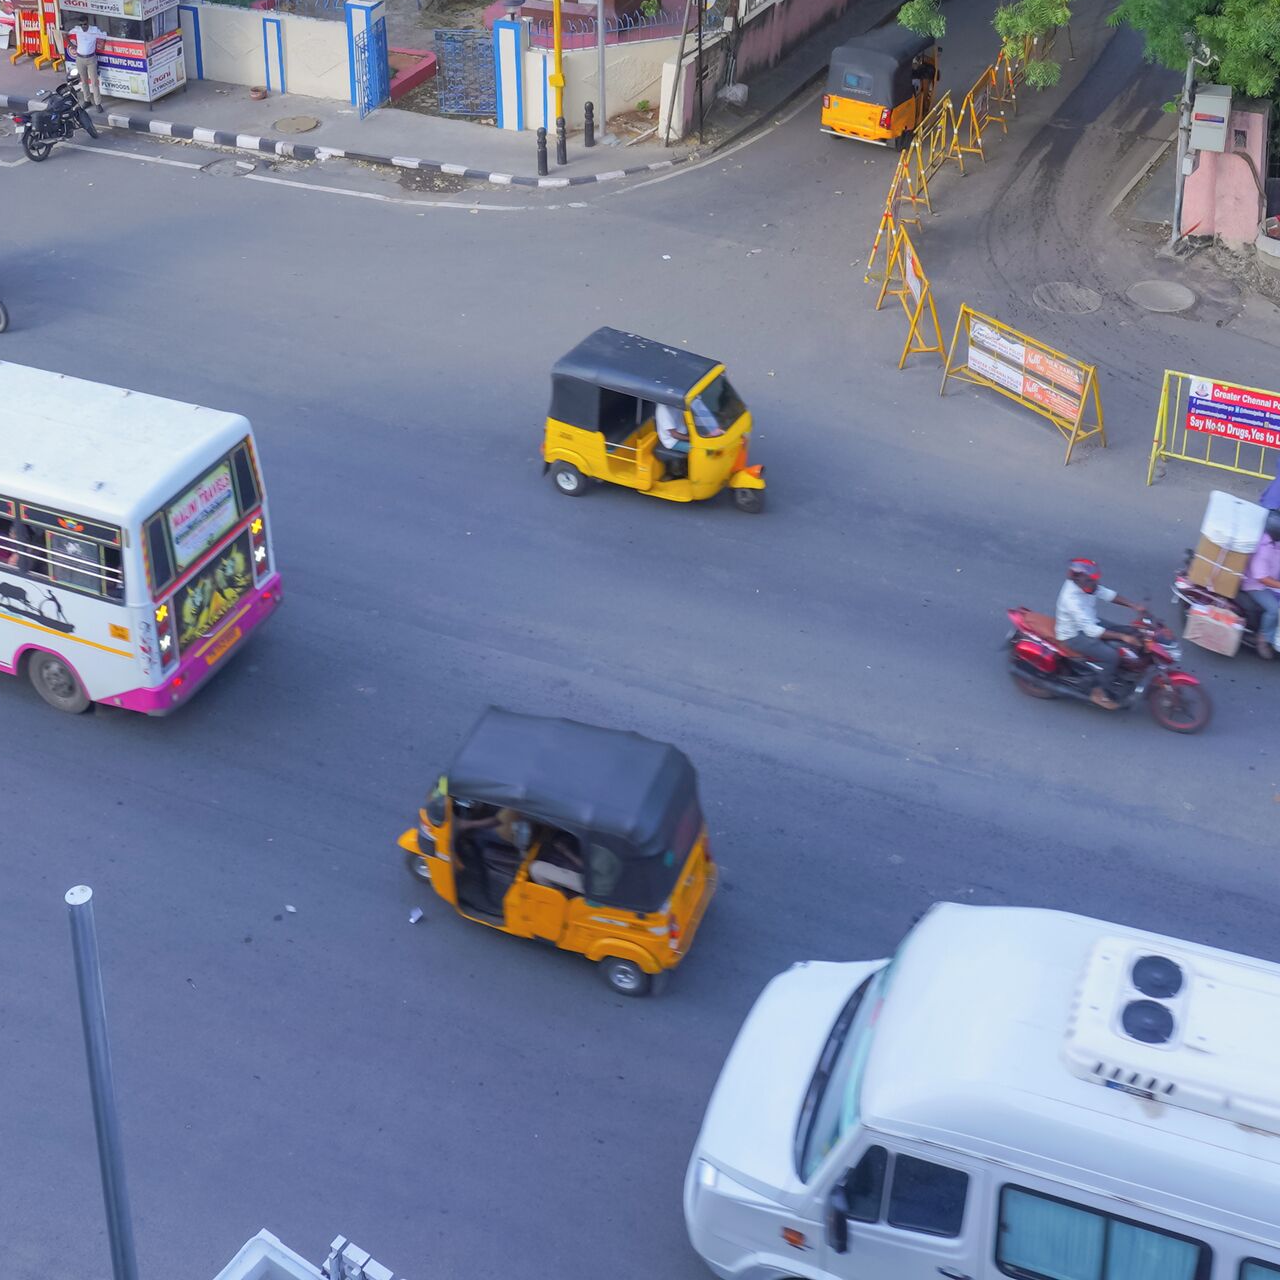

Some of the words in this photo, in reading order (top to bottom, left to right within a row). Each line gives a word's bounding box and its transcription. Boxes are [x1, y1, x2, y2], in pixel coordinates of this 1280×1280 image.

[109, 57, 127, 66] TRAFFIC
[127, 60, 144, 68] POLICE
[1214, 388, 1241, 402] Greater
[1242, 394, 1272, 408] Chennai
[1189, 416, 1204, 430] Say
[1266, 433, 1275, 444] to
